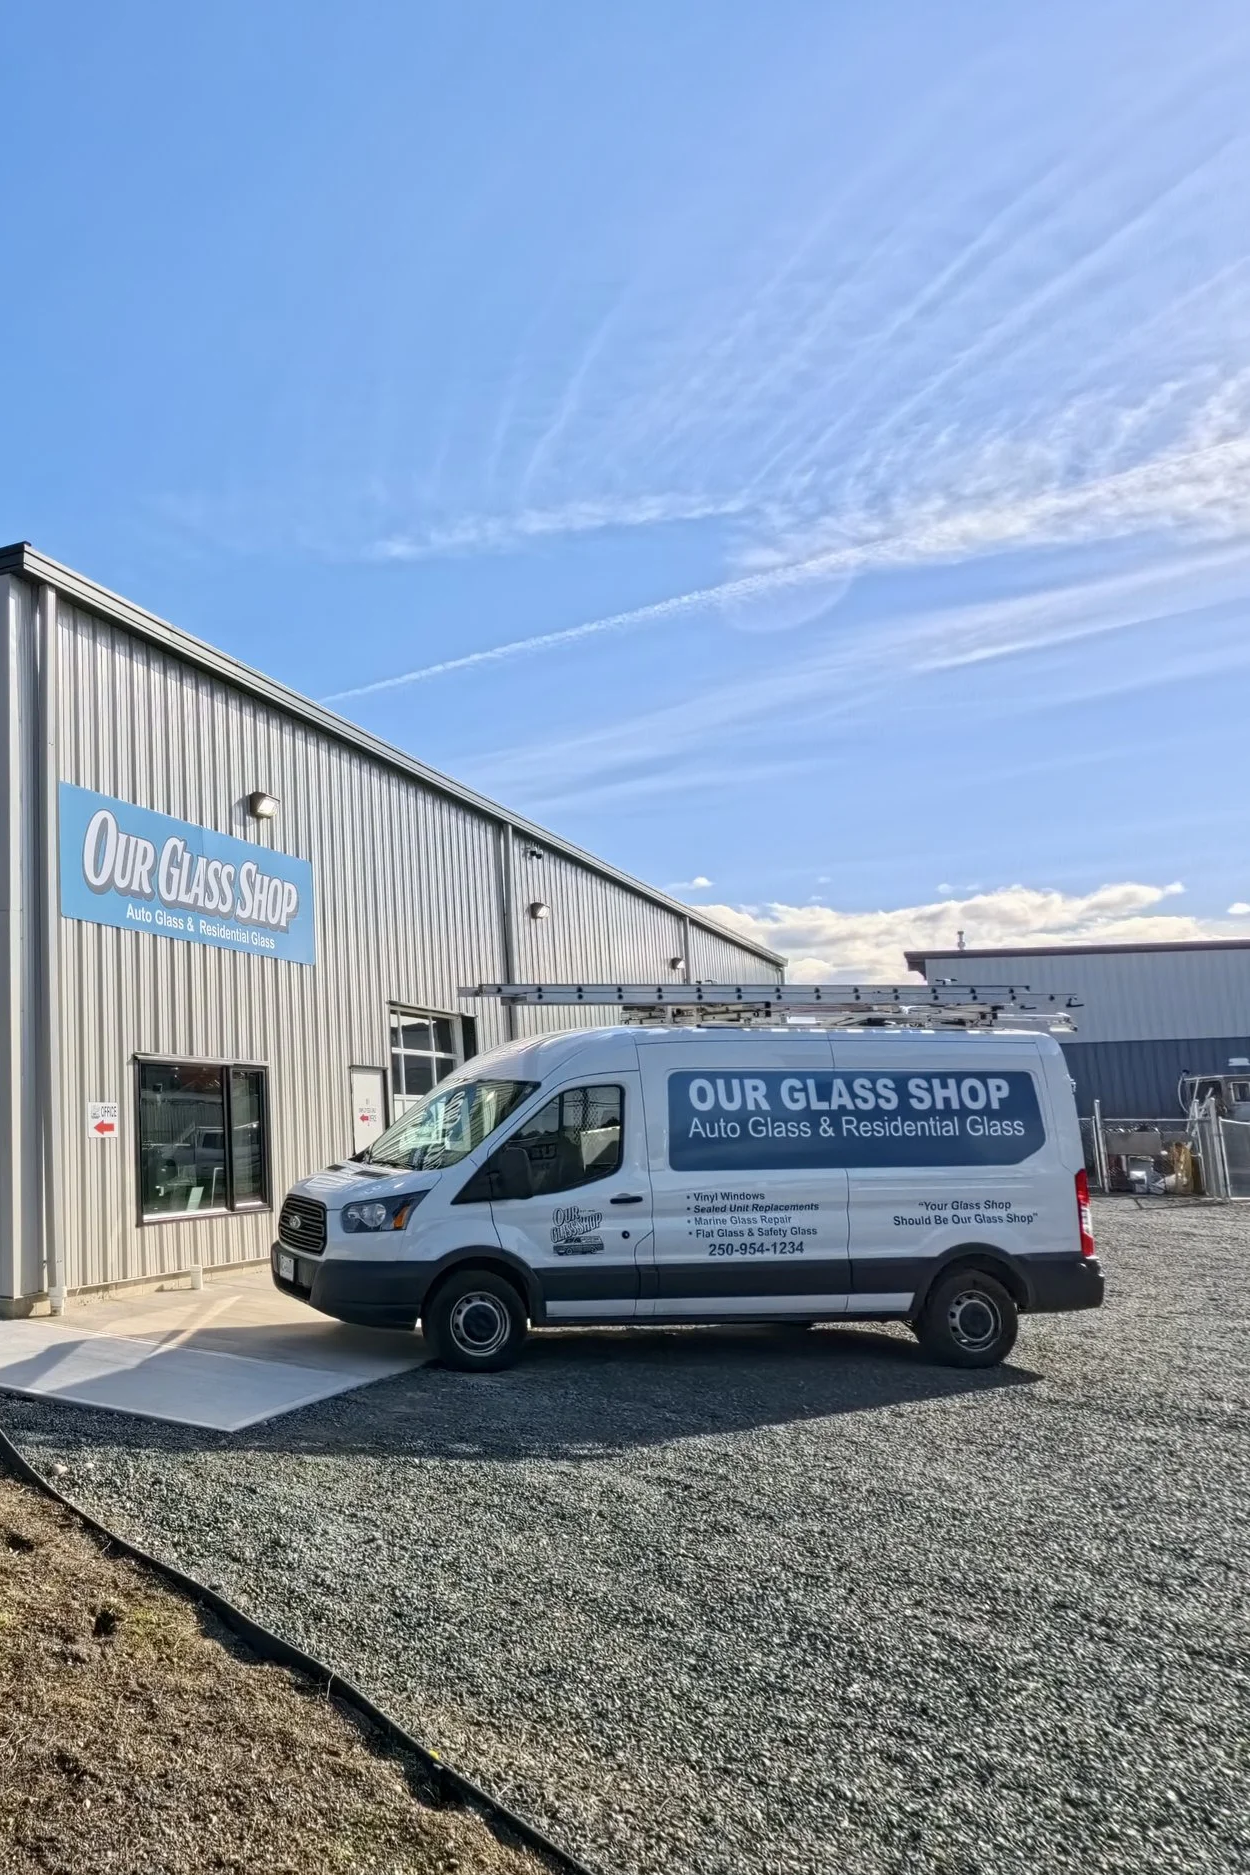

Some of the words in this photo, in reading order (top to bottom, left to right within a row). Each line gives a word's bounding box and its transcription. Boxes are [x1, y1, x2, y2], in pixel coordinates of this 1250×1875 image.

[83, 808, 154, 895] OUR
[158, 836, 235, 914] GLASS
[236, 861, 299, 928] SHOP
[126, 903, 152, 923] Auto
[155, 909, 184, 930] Glass
[186, 916, 195, 932] &
[199, 919, 249, 945] Residential
[251, 931, 276, 950] Glass
[688, 1077, 771, 1112] OUR
[780, 1077, 899, 1112] GLASS
[906, 1077, 1010, 1111] SHOP
[688, 1116, 741, 1138] Auto
[748, 1116, 812, 1138] Glass
[819, 1116, 836, 1138] &
[841, 1115, 959, 1138] Residential
[966, 1115, 1026, 1137] Glass
[693, 1192, 718, 1203] Vinyl
[720, 1191, 766, 1201] Windows
[693, 1204, 727, 1214] Sealed
[729, 1203, 749, 1213] Unit
[751, 1202, 820, 1214] Replacements
[951, 1200, 981, 1210] Glass
[983, 1200, 1012, 1211] Shop
[553, 1205, 581, 1227] OUR
[694, 1216, 727, 1226] Marine
[729, 1215, 758, 1225] Glass
[760, 1214, 792, 1225] Repair
[893, 1215, 931, 1226] Should
[934, 1214, 949, 1225] Be
[951, 1214, 972, 1224] Our
[974, 1213, 1004, 1224] Glass
[696, 1228, 714, 1239] Flat
[717, 1227, 745, 1238] Glass
[747, 1227, 755, 1237] &
[757, 1226, 788, 1238] Safety
[790, 1226, 818, 1236] Glass
[708, 1240, 804, 1257] 250-954-1234
